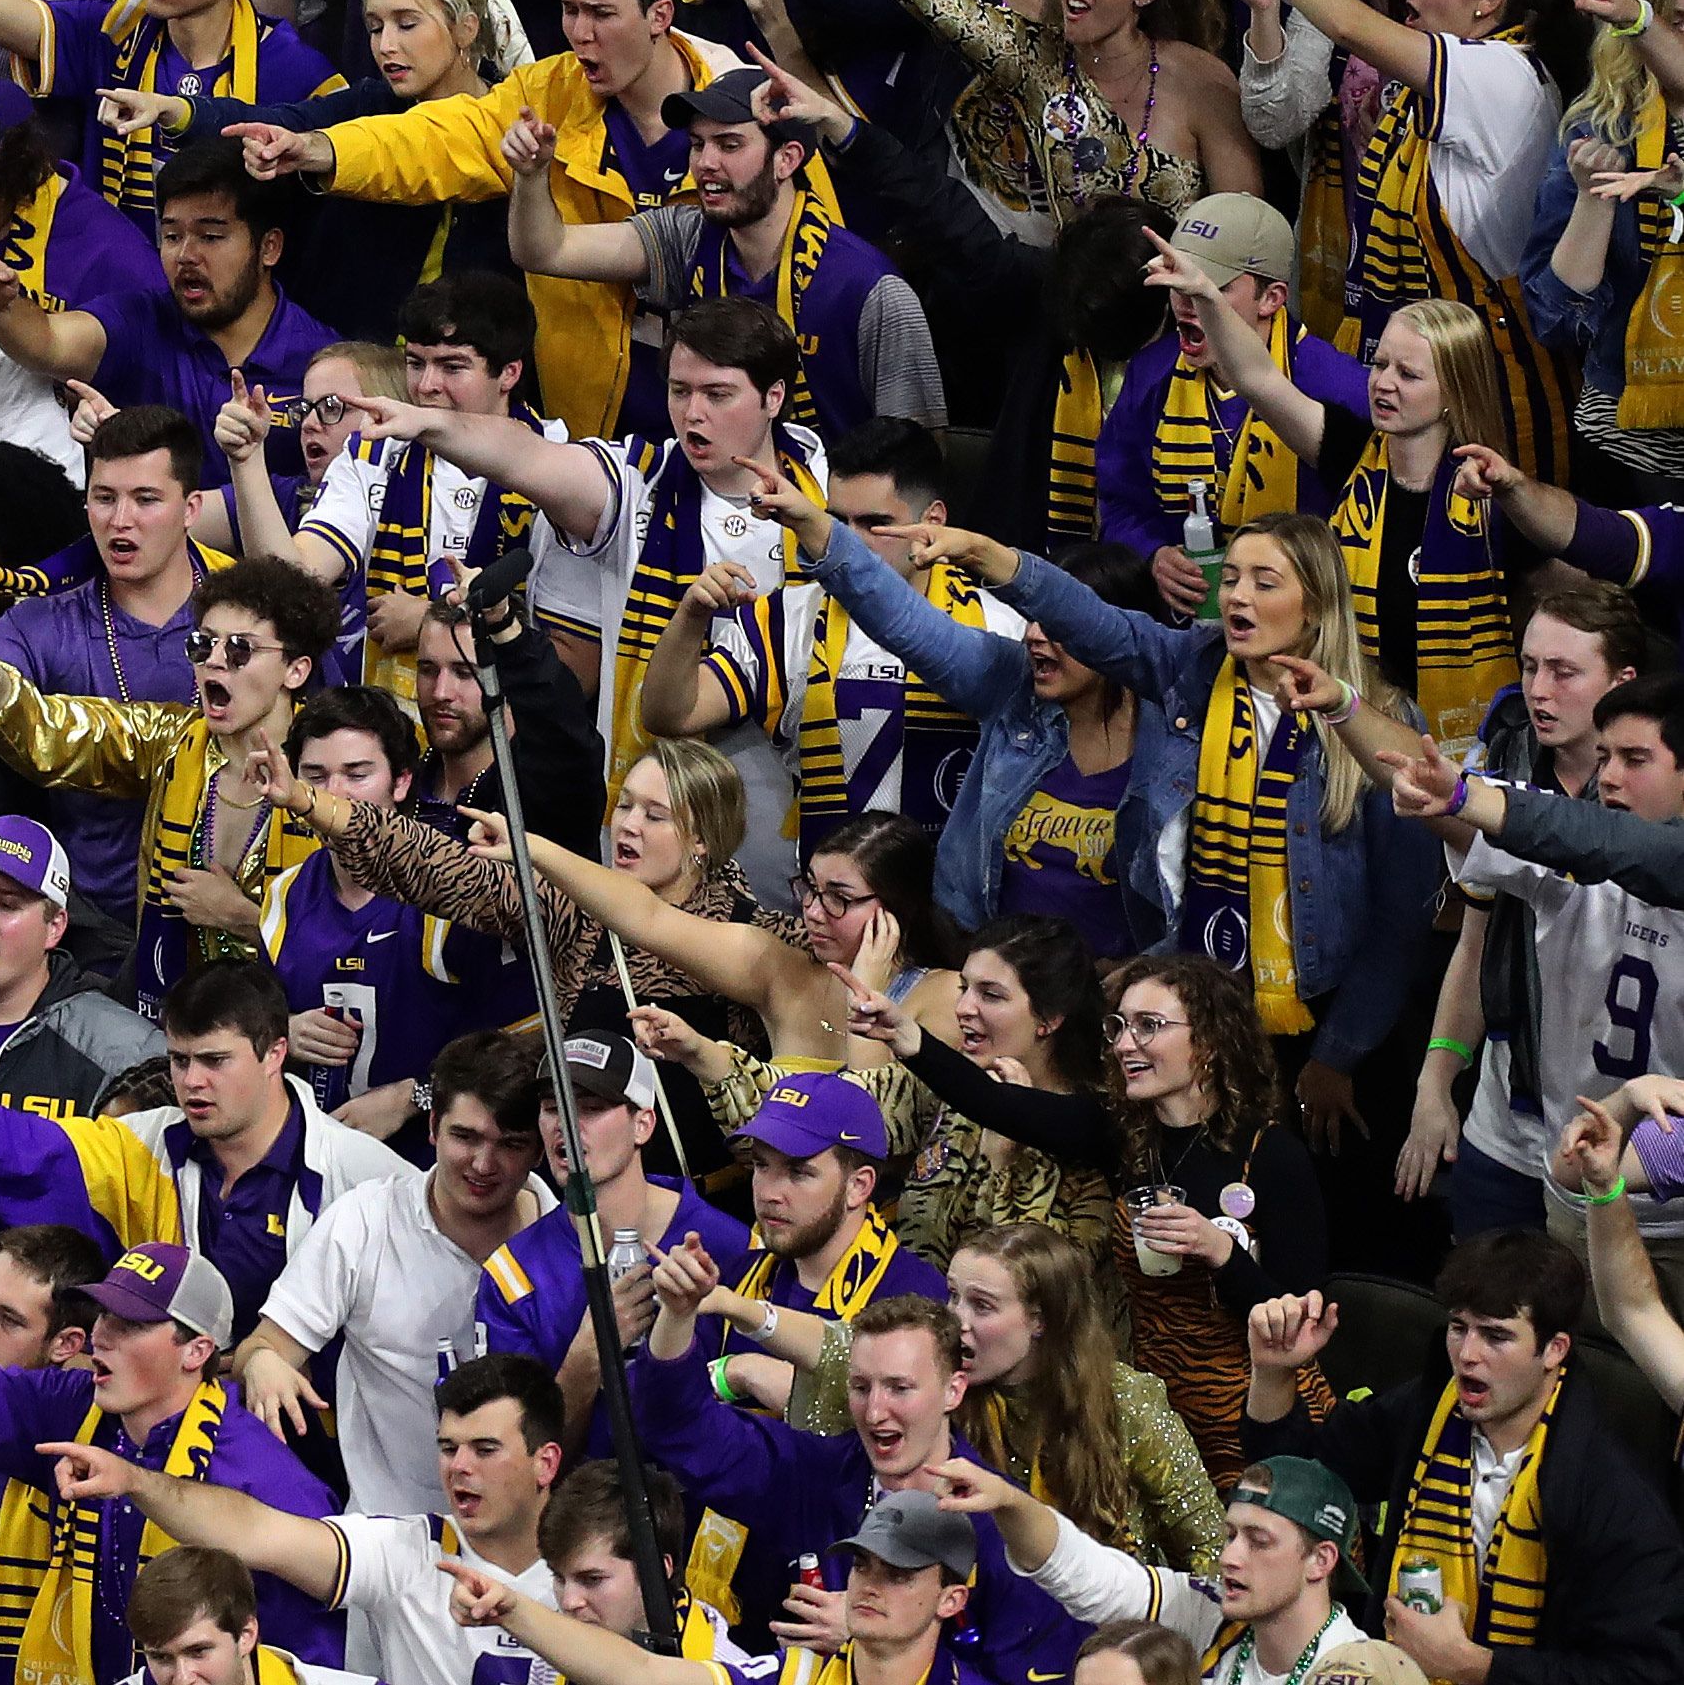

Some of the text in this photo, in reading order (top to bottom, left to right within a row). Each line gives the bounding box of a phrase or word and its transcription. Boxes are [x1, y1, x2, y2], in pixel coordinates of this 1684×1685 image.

[636, 193, 661, 206] SU
[1181, 220, 1218, 239] LSU
[867, 663, 906, 680] LSU
[1015, 806, 1112, 843] FOREVER
[1073, 834, 1106, 860] LSU
[334, 955, 366, 972] LSU
[1591, 956, 1662, 1078] 9
[1, 1093, 76, 1120] LSU
[770, 1088, 809, 1107] LSU
